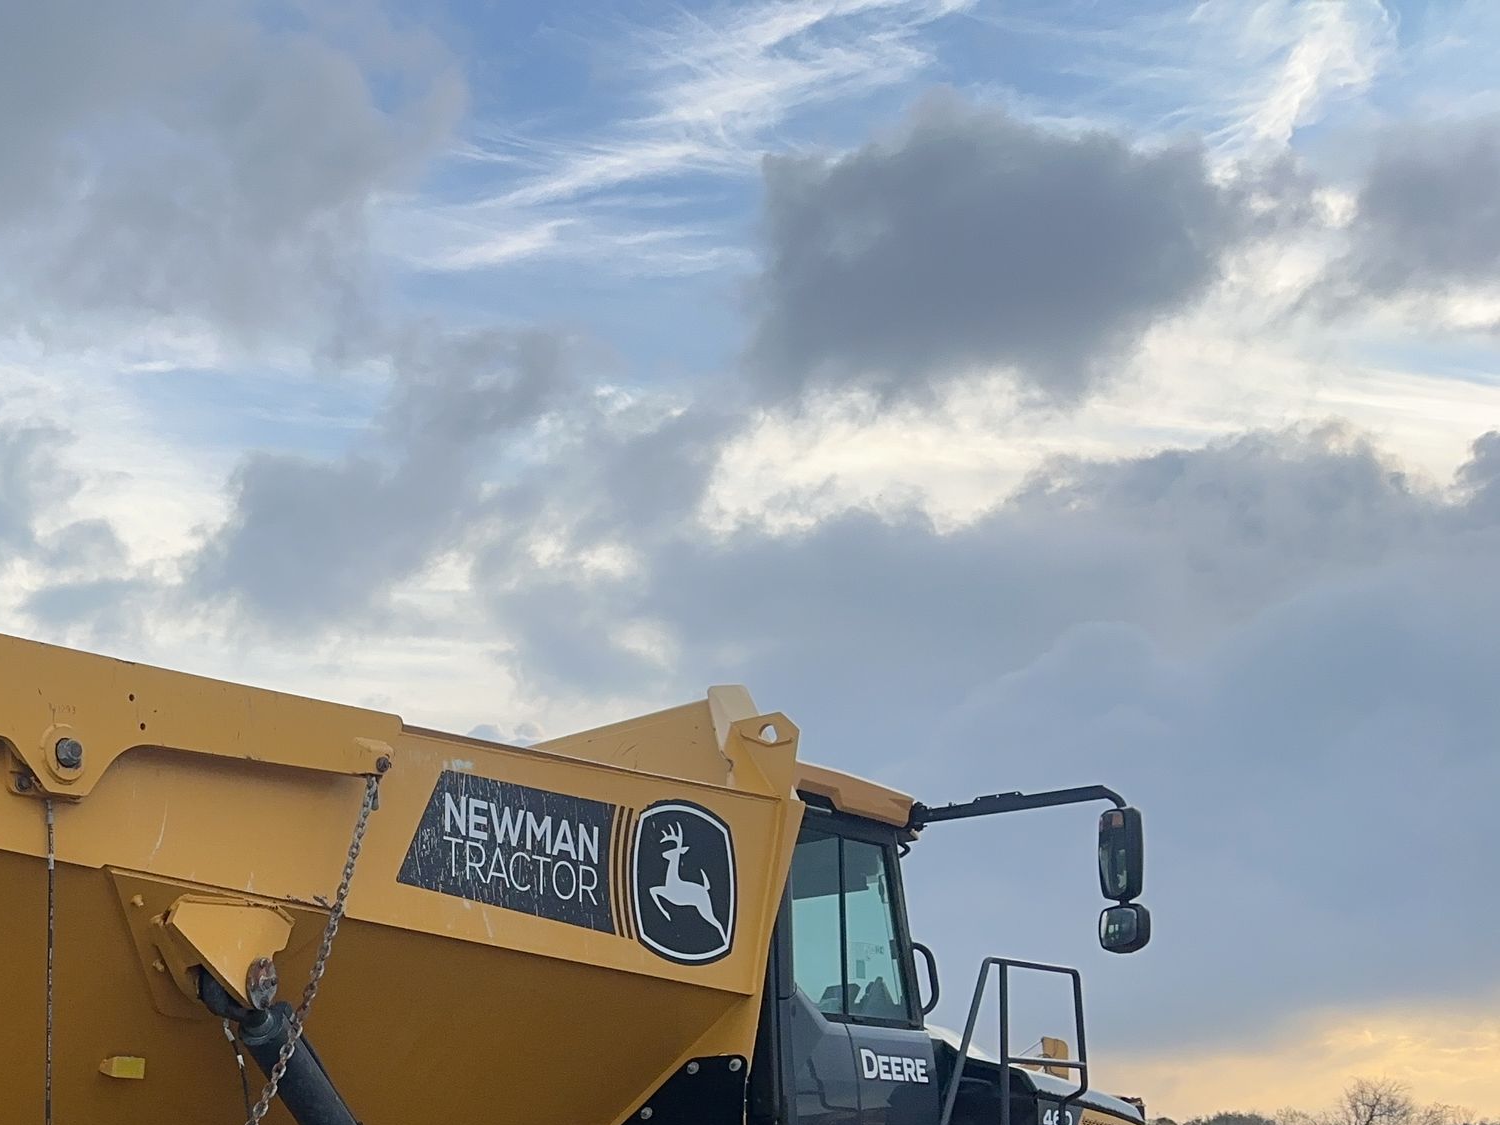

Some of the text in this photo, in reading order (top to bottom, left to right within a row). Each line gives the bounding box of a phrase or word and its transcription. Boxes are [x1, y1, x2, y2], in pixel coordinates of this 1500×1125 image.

[444, 792, 599, 865] NEWMAN
[443, 835, 598, 906] TRACTOR
[860, 1048, 929, 1083] DEERE
